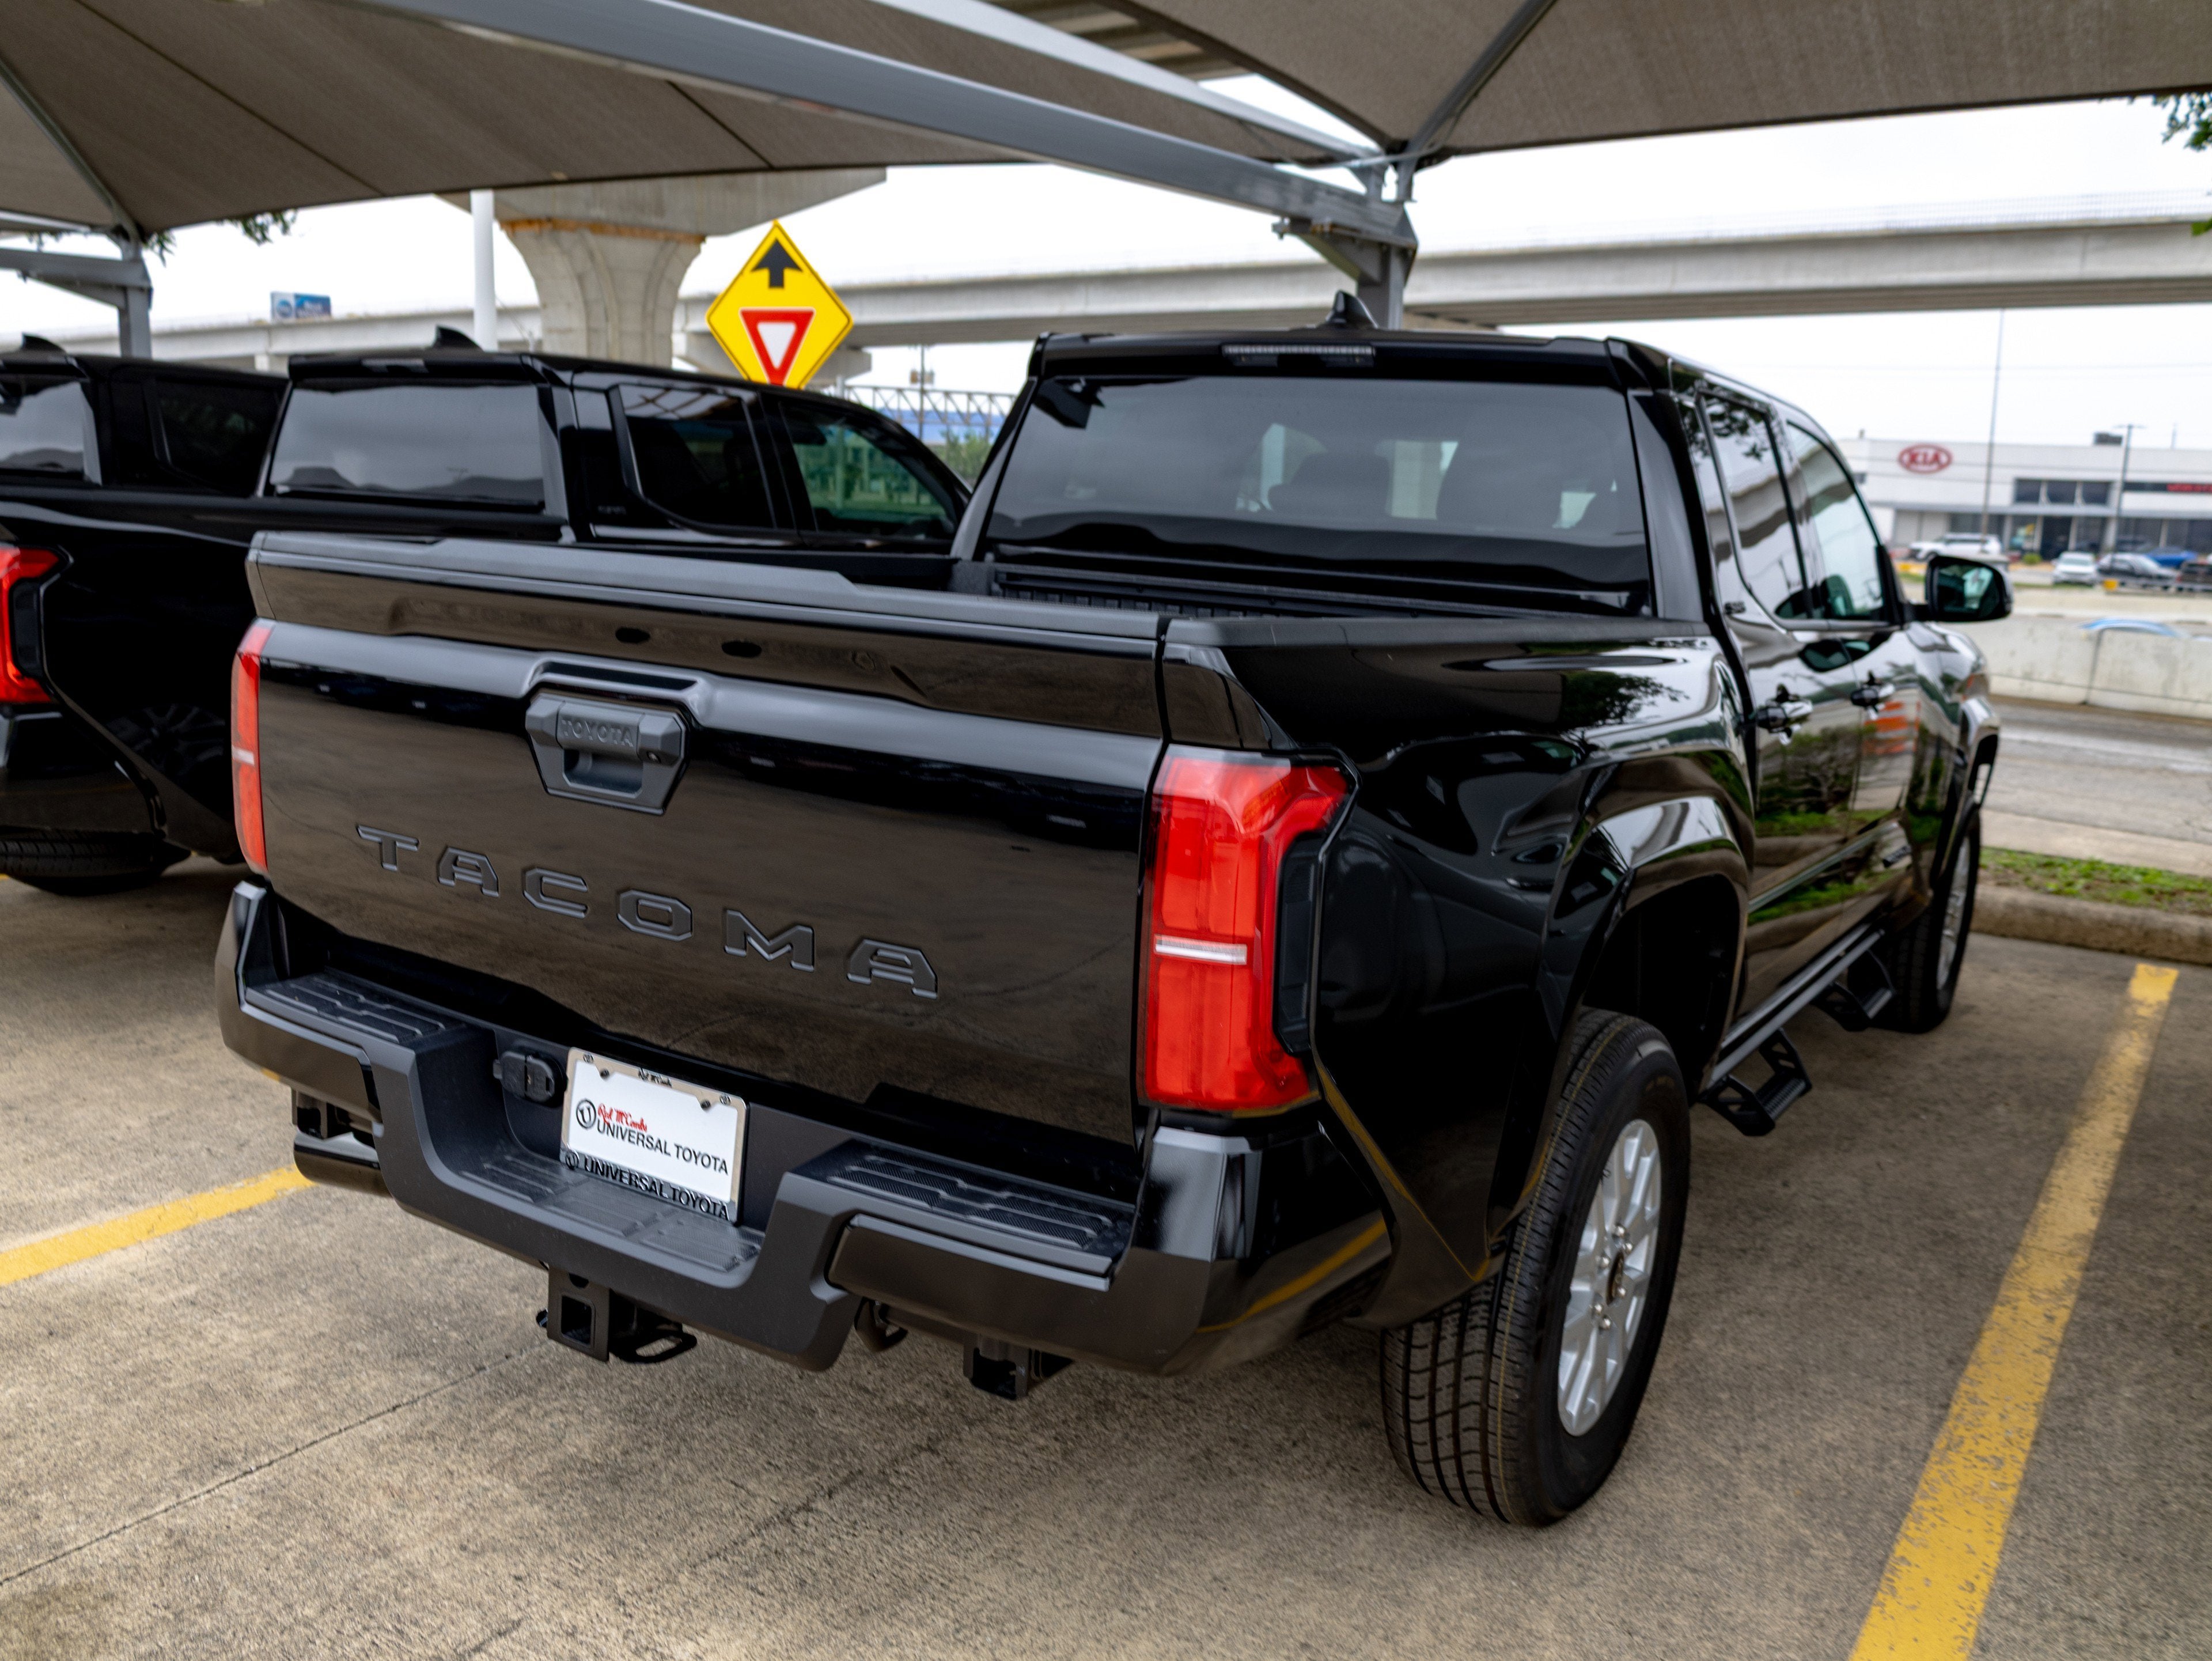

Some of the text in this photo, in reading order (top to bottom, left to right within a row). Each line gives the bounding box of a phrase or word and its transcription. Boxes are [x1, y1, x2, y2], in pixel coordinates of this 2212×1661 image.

[562, 720, 633, 748] TOYOTA
[357, 824, 938, 1000] TACOMA
[597, 1118, 729, 1176] UNIVERSAL TOYOTA
[584, 1155, 730, 1221] UNIVERSAL TOYOTA
